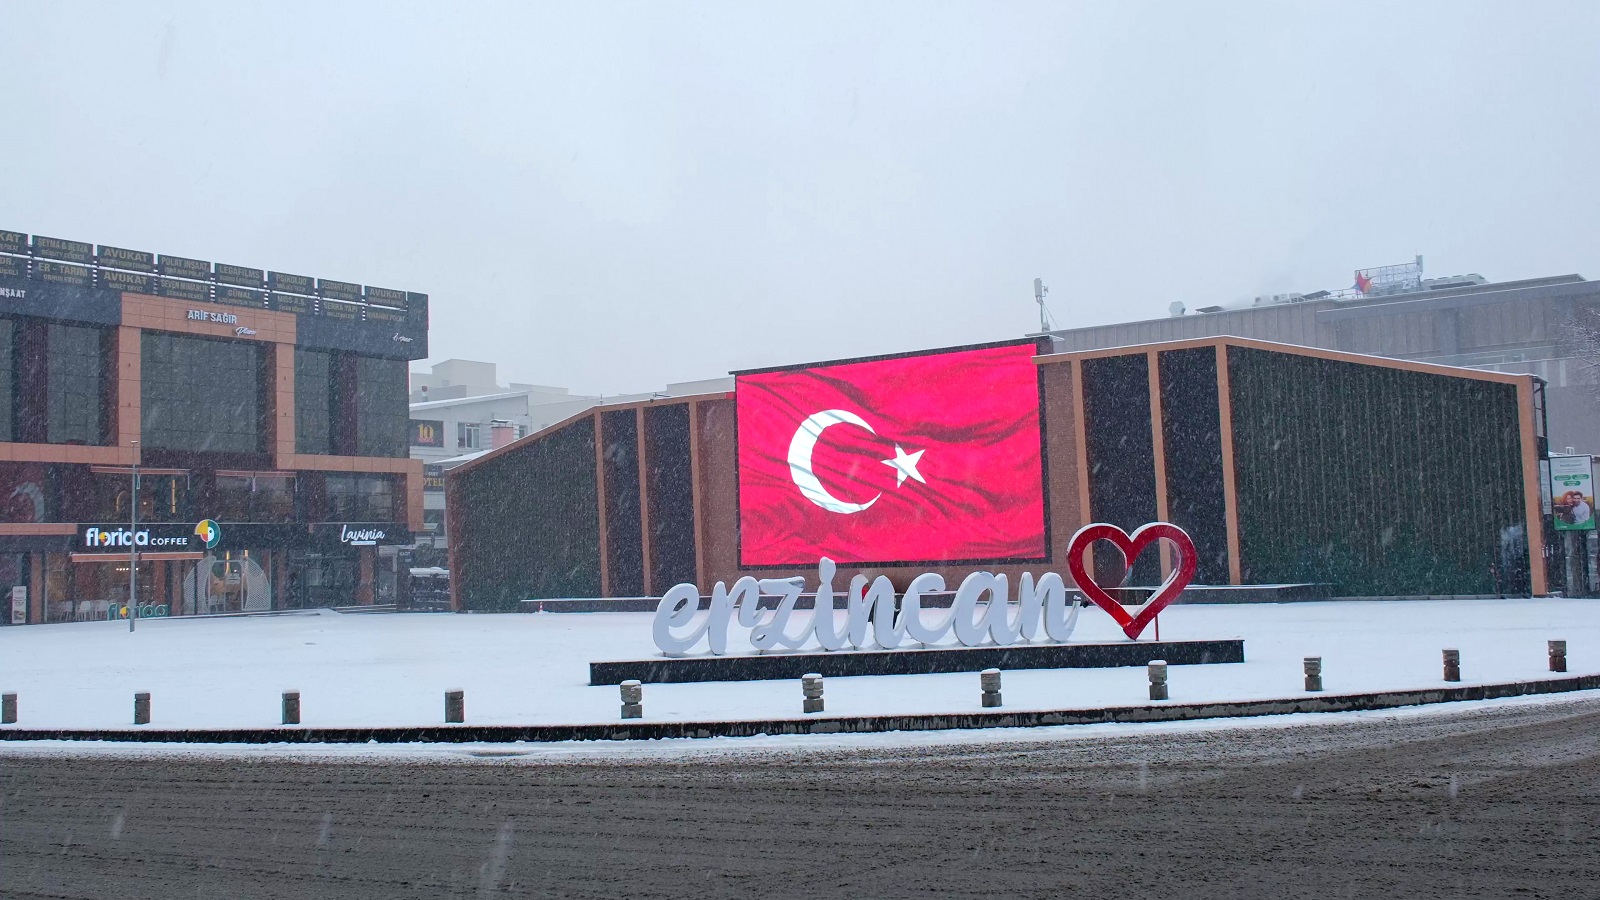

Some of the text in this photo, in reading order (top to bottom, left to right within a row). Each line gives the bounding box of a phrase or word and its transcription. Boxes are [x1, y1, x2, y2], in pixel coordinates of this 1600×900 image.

[103, 248, 148, 262] AVUKAT
[161, 257, 183, 267] POLAT
[38, 262, 51, 272] ER
[103, 271, 148, 285] AVUKAT
[369, 288, 402, 300] AVUKAT
[187, 309, 237, 325] ARİF SAĞIR
[416, 423, 434, 439] 10
[340, 524, 386, 543] Lavinia
[150, 537, 188, 546] COFFEE
[653, 557, 1079, 656] erzincan
